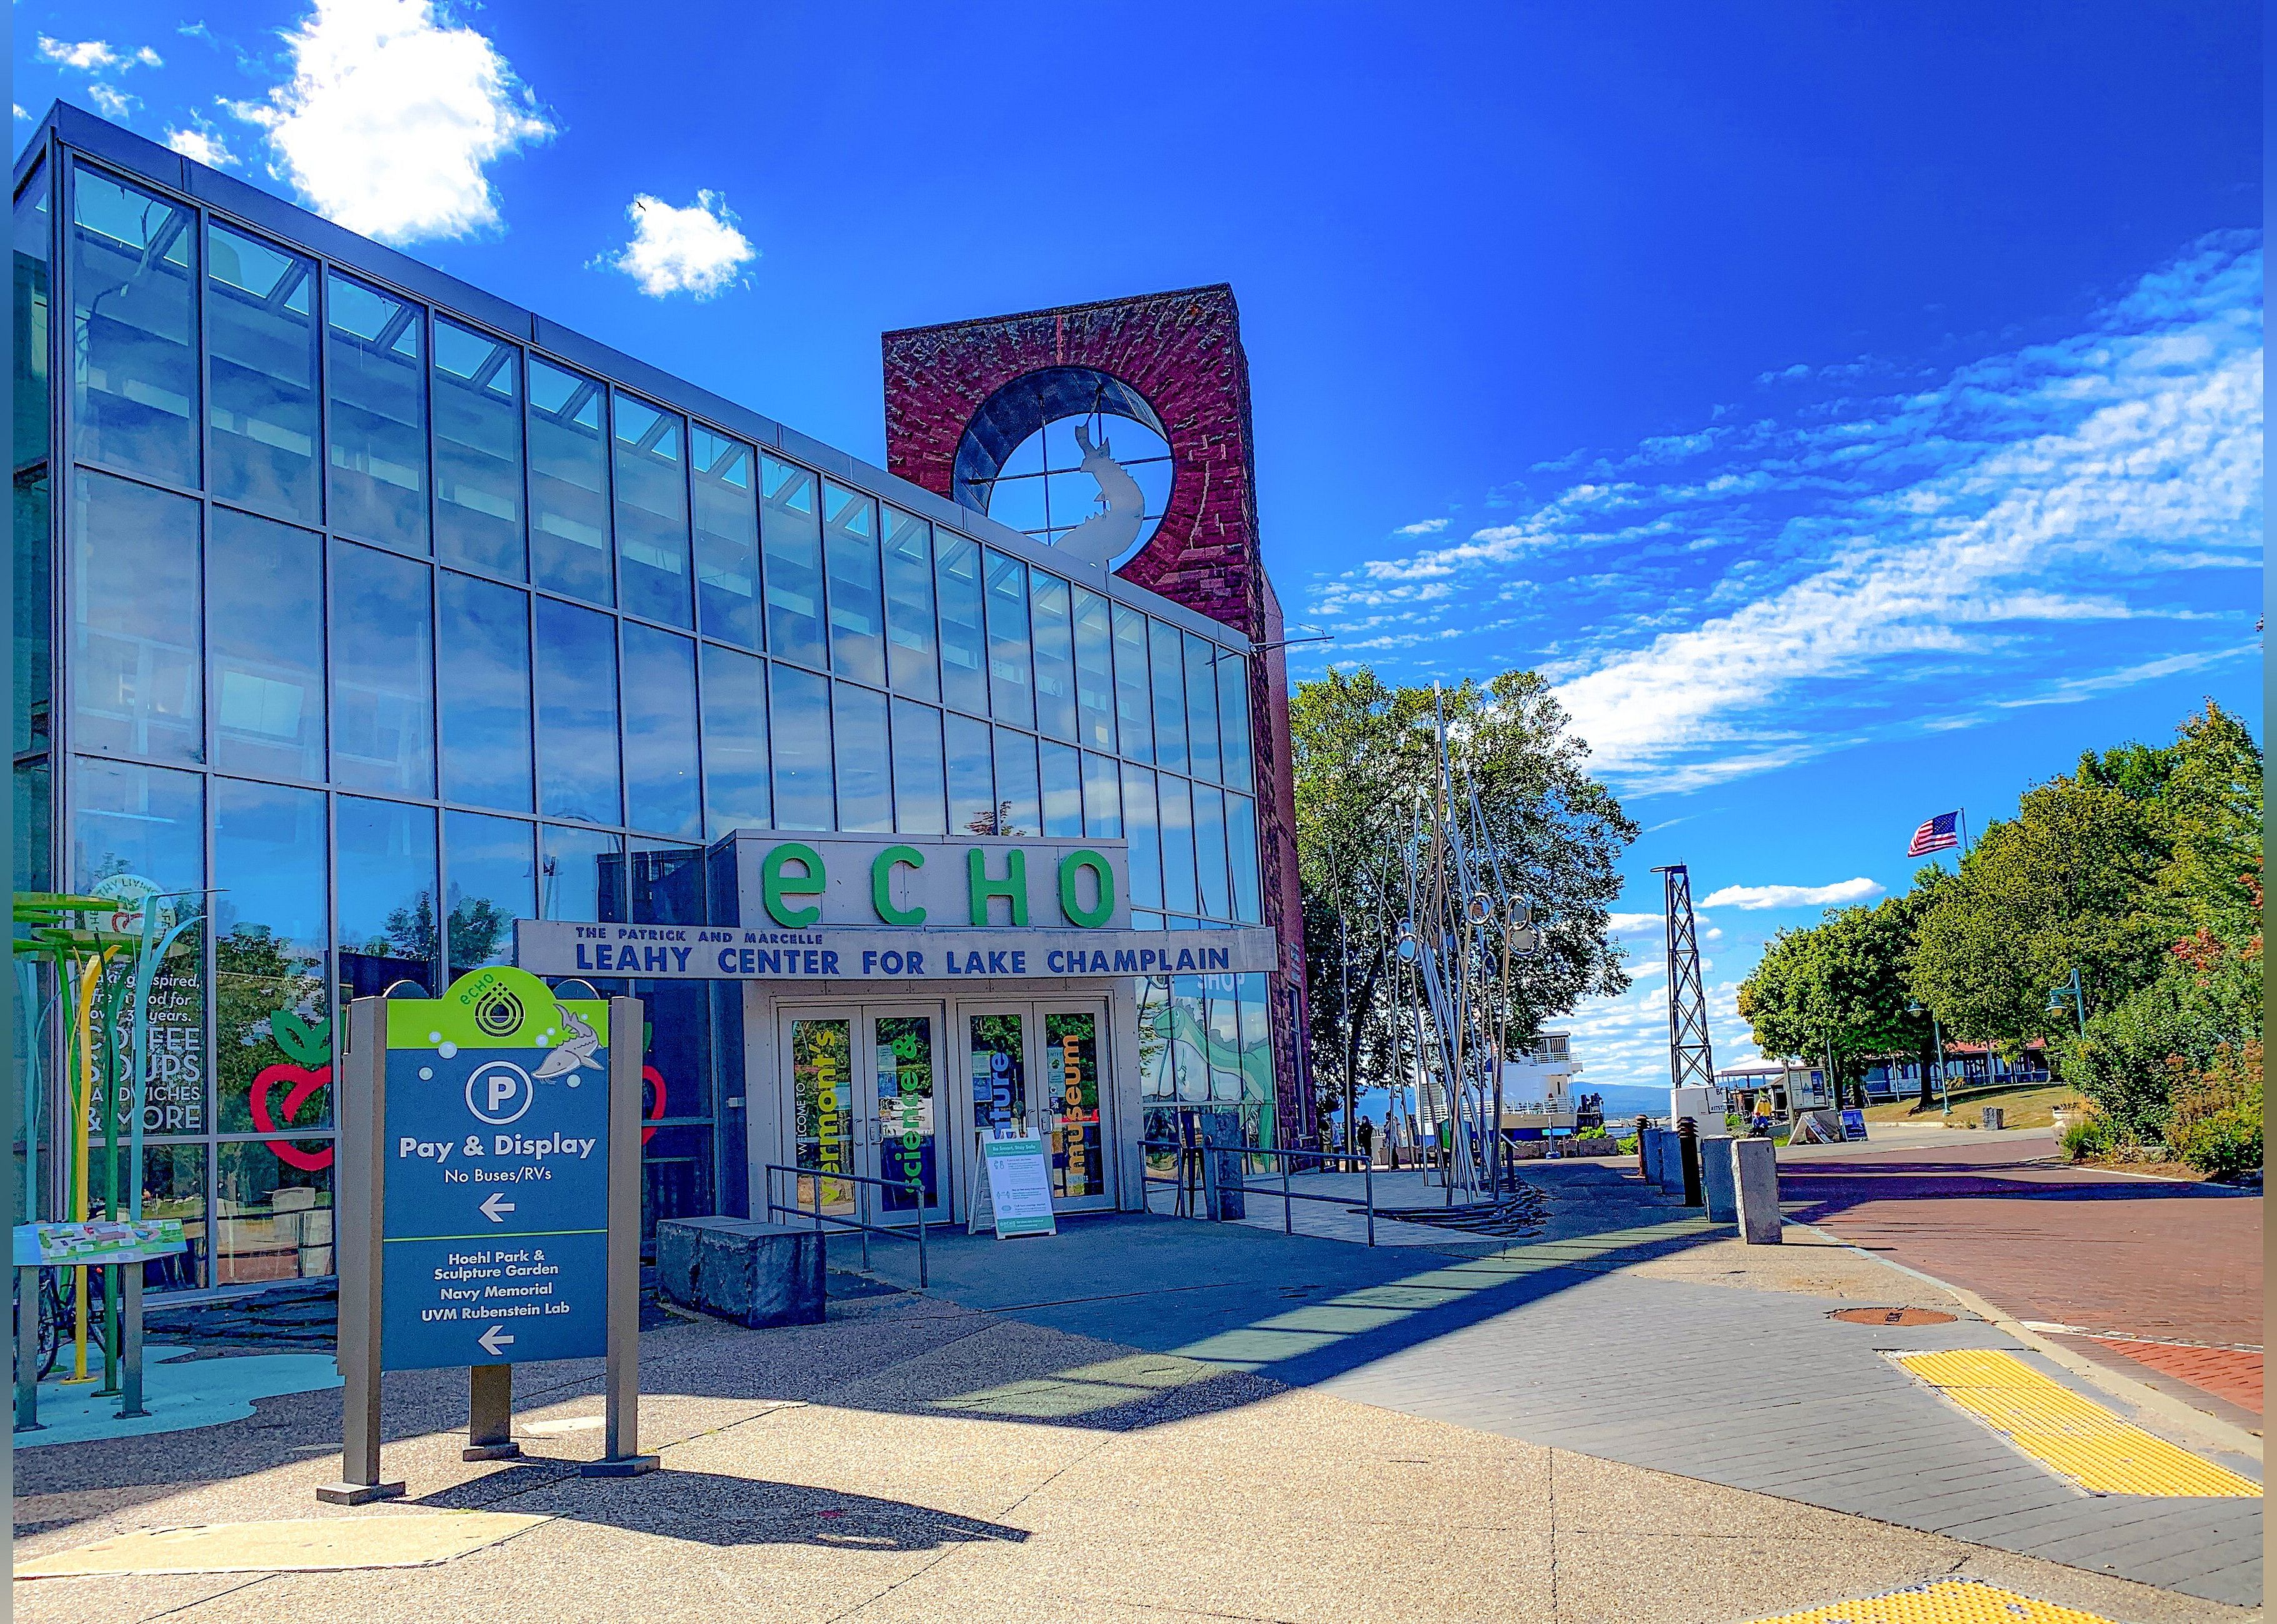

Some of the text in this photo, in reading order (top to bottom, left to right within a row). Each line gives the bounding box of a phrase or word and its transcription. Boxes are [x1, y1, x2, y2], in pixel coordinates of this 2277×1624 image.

[576, 926, 823, 945] THE PATRICK AND MARCELLE
[576, 943, 1229, 975] LEAHY CENTER FOR LAKE CHAMPLAIN
[169, 991, 192, 1008] for
[149, 1011, 192, 1025] years.
[488, 1076, 517, 1111] P
[891, 1031, 923, 1194] science &
[1063, 1035, 1085, 1175] museum
[796, 1082, 808, 1155] WELCOME TO
[809, 1030, 840, 1206] vermont's
[399, 1132, 596, 1163] Pay & Display
[445, 1166, 552, 1183] No Buses/RVs
[448, 1249, 545, 1265] Hoehl Park &
[434, 1263, 559, 1282] Sculpture Garden
[440, 1282, 553, 1302] Navy Memorial
[421, 1301, 570, 1322] UVM Rubenstein Lab
